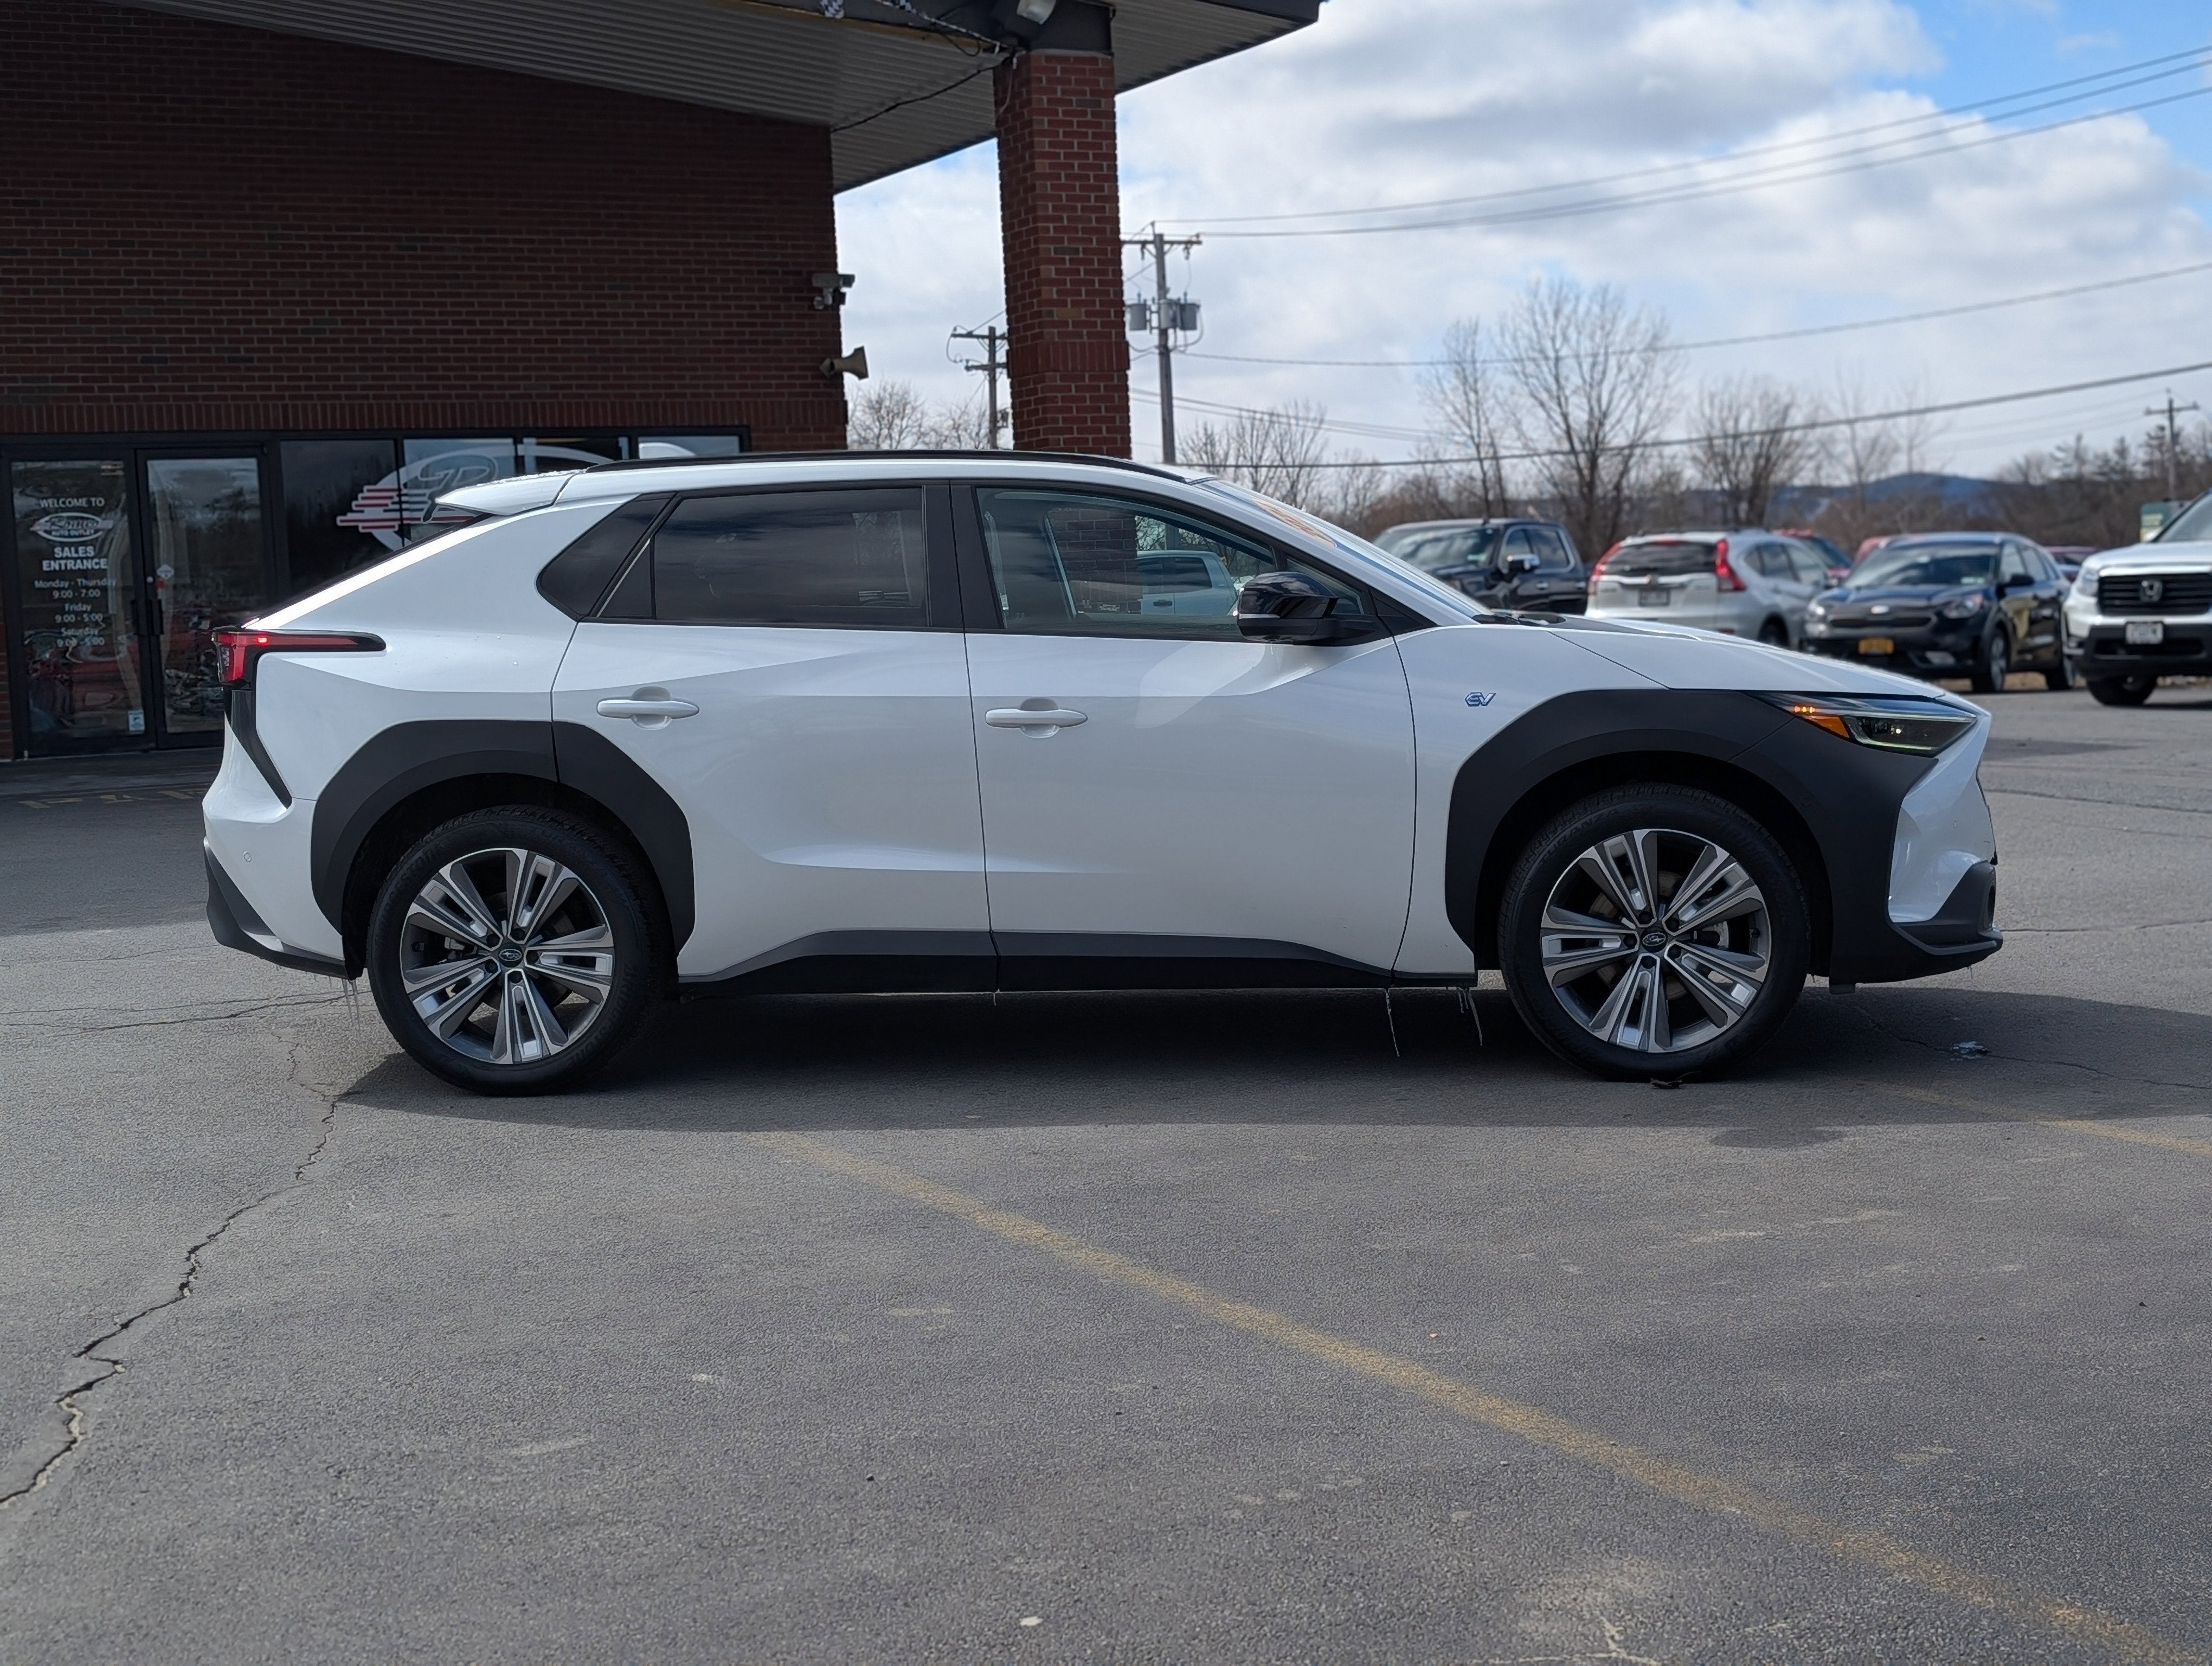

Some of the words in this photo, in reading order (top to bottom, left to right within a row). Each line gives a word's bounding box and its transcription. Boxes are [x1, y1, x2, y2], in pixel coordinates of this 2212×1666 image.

[39, 498, 88, 508] WELCOME
[89, 497, 105, 507] TO
[54, 546, 95, 558] SALES
[42, 558, 108, 571] ENTRANCE
[34, 579, 69, 588] Monday
[65, 603, 92, 612] Friday
[61, 626, 99, 637] Saturday
[1465, 692, 1496, 707] EV
